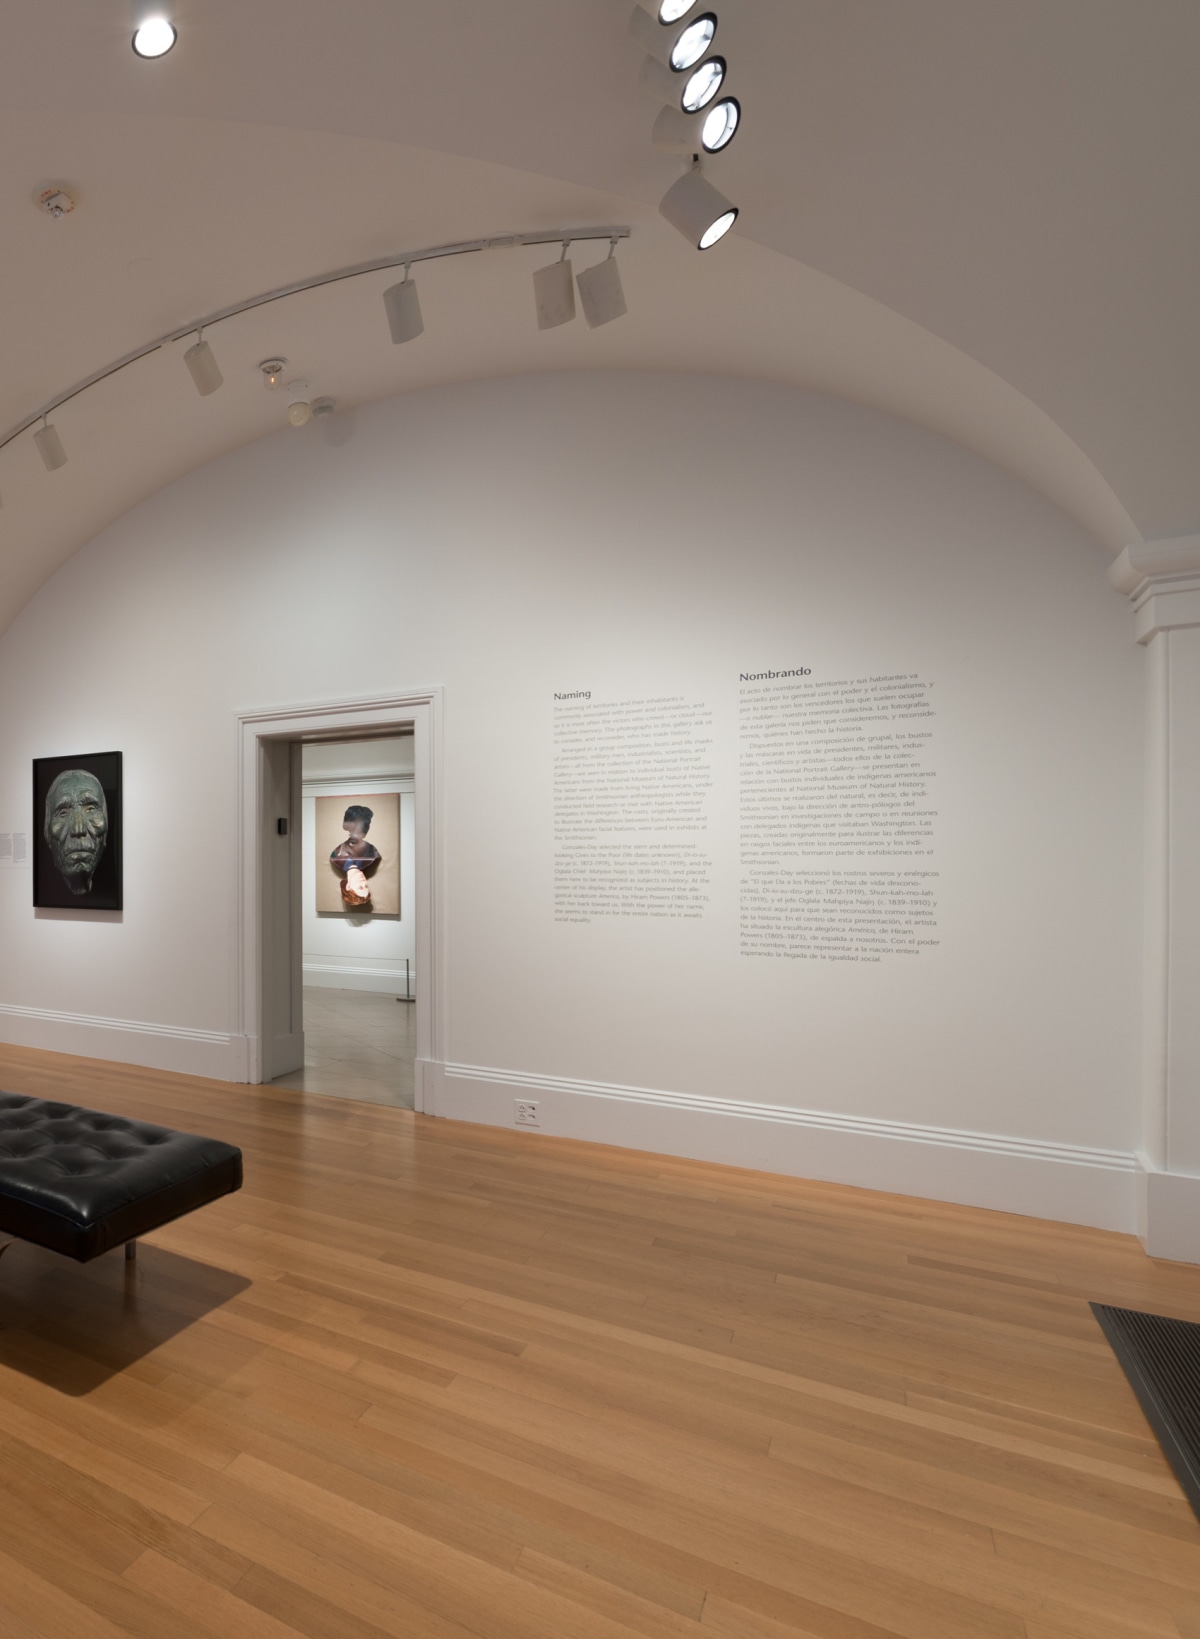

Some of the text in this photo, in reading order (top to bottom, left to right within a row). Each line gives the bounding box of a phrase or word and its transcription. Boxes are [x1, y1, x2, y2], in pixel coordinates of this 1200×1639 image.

[740, 666, 812, 682] Nombrando
[815, 679, 848, 688] territorios
[869, 674, 907, 683] habitantes
[554, 690, 591, 701] Naming
[740, 695, 768, 703] asociado
[790, 691, 816, 701] general
[841, 688, 862, 696] poder
[809, 708, 840, 716] memoria
[872, 762, 909, 771] presentan
[740, 786, 787, 795] pertenecientes
[791, 812, 842, 820] investigaciones
[790, 831, 837, 839] originalmente
